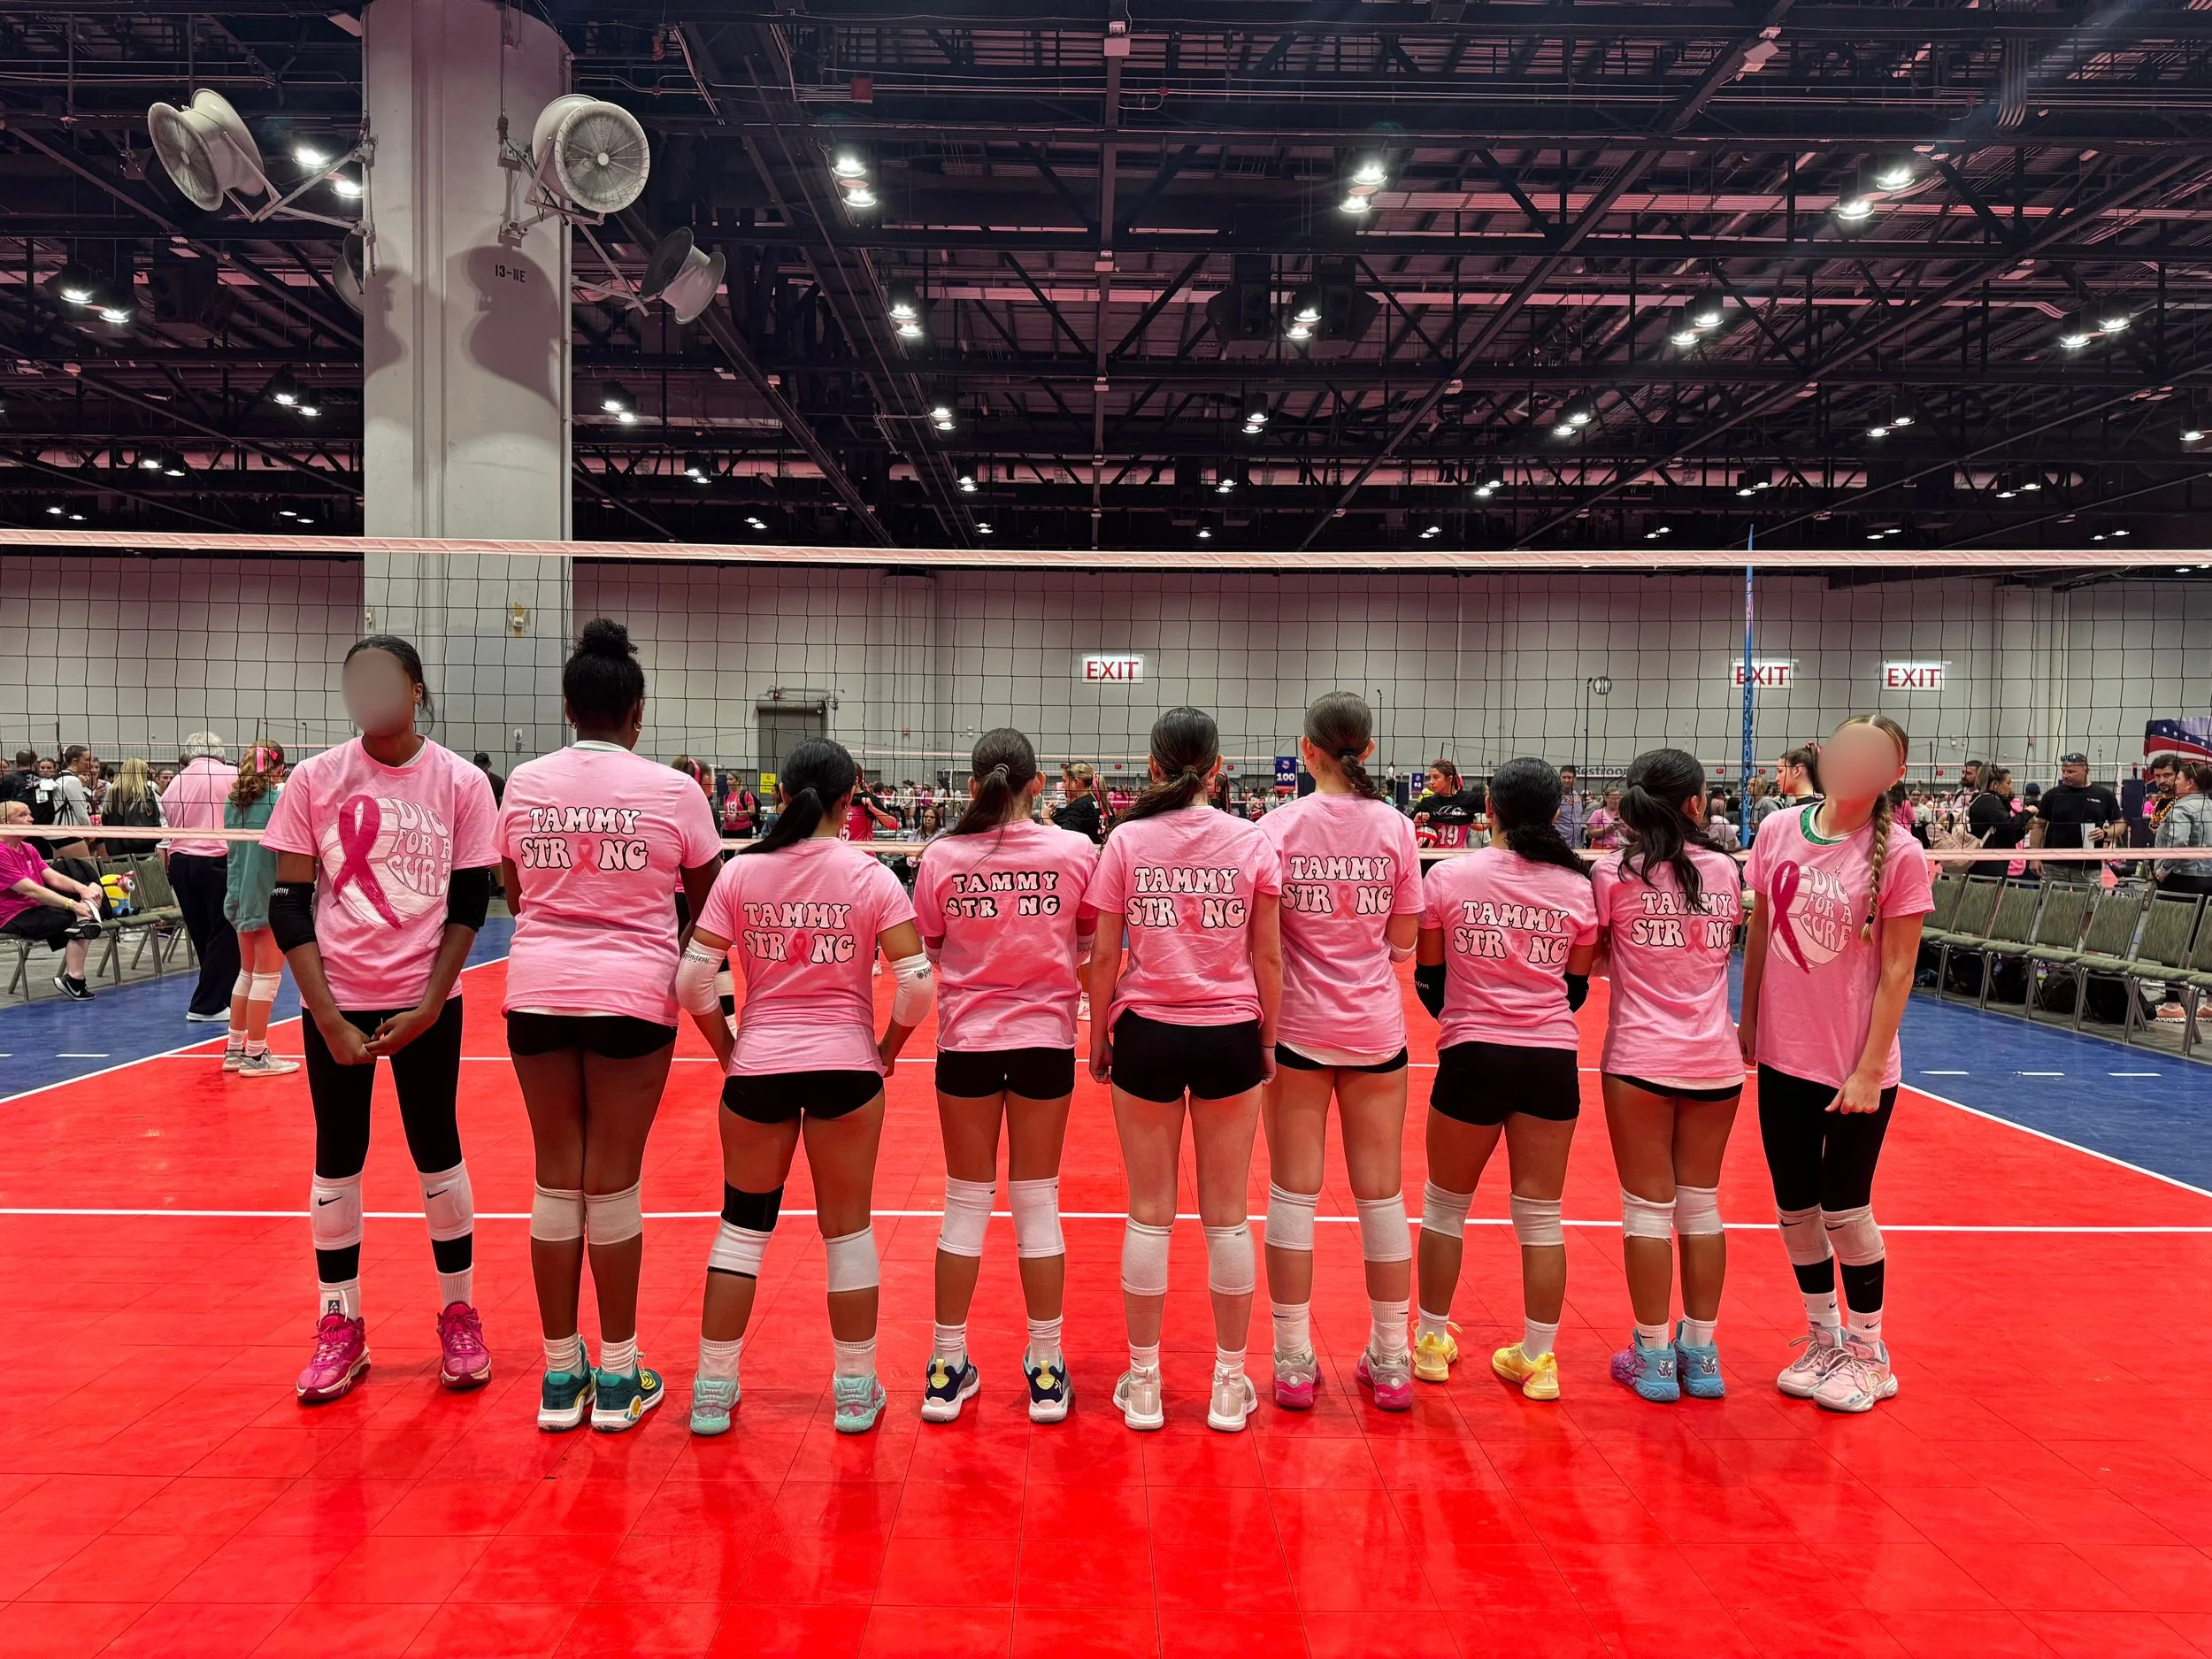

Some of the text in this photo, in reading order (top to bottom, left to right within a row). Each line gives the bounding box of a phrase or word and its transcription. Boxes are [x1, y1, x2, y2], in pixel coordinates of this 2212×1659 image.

[495, 265, 526, 283] 13-NE
[1087, 661, 1140, 680] EXIT
[1736, 665, 1789, 686] EXIT
[1887, 668, 1940, 687] EXIT
[1276, 772, 1295, 781] 100
[529, 806, 641, 834] TAMMY
[391, 828, 434, 856] FOR
[1437, 824, 1460, 846] 19
[386, 854, 450, 897] CURE
[1134, 867, 1239, 894] TAMMY
[1290, 856, 1390, 881] TAMMY
[951, 871, 1059, 894] TAMMY
[742, 902, 851, 929] TAMMY
[1463, 900, 1570, 933] TAMMY
[1804, 893, 1853, 925] FOR A
[1800, 911, 1853, 952] CURE
